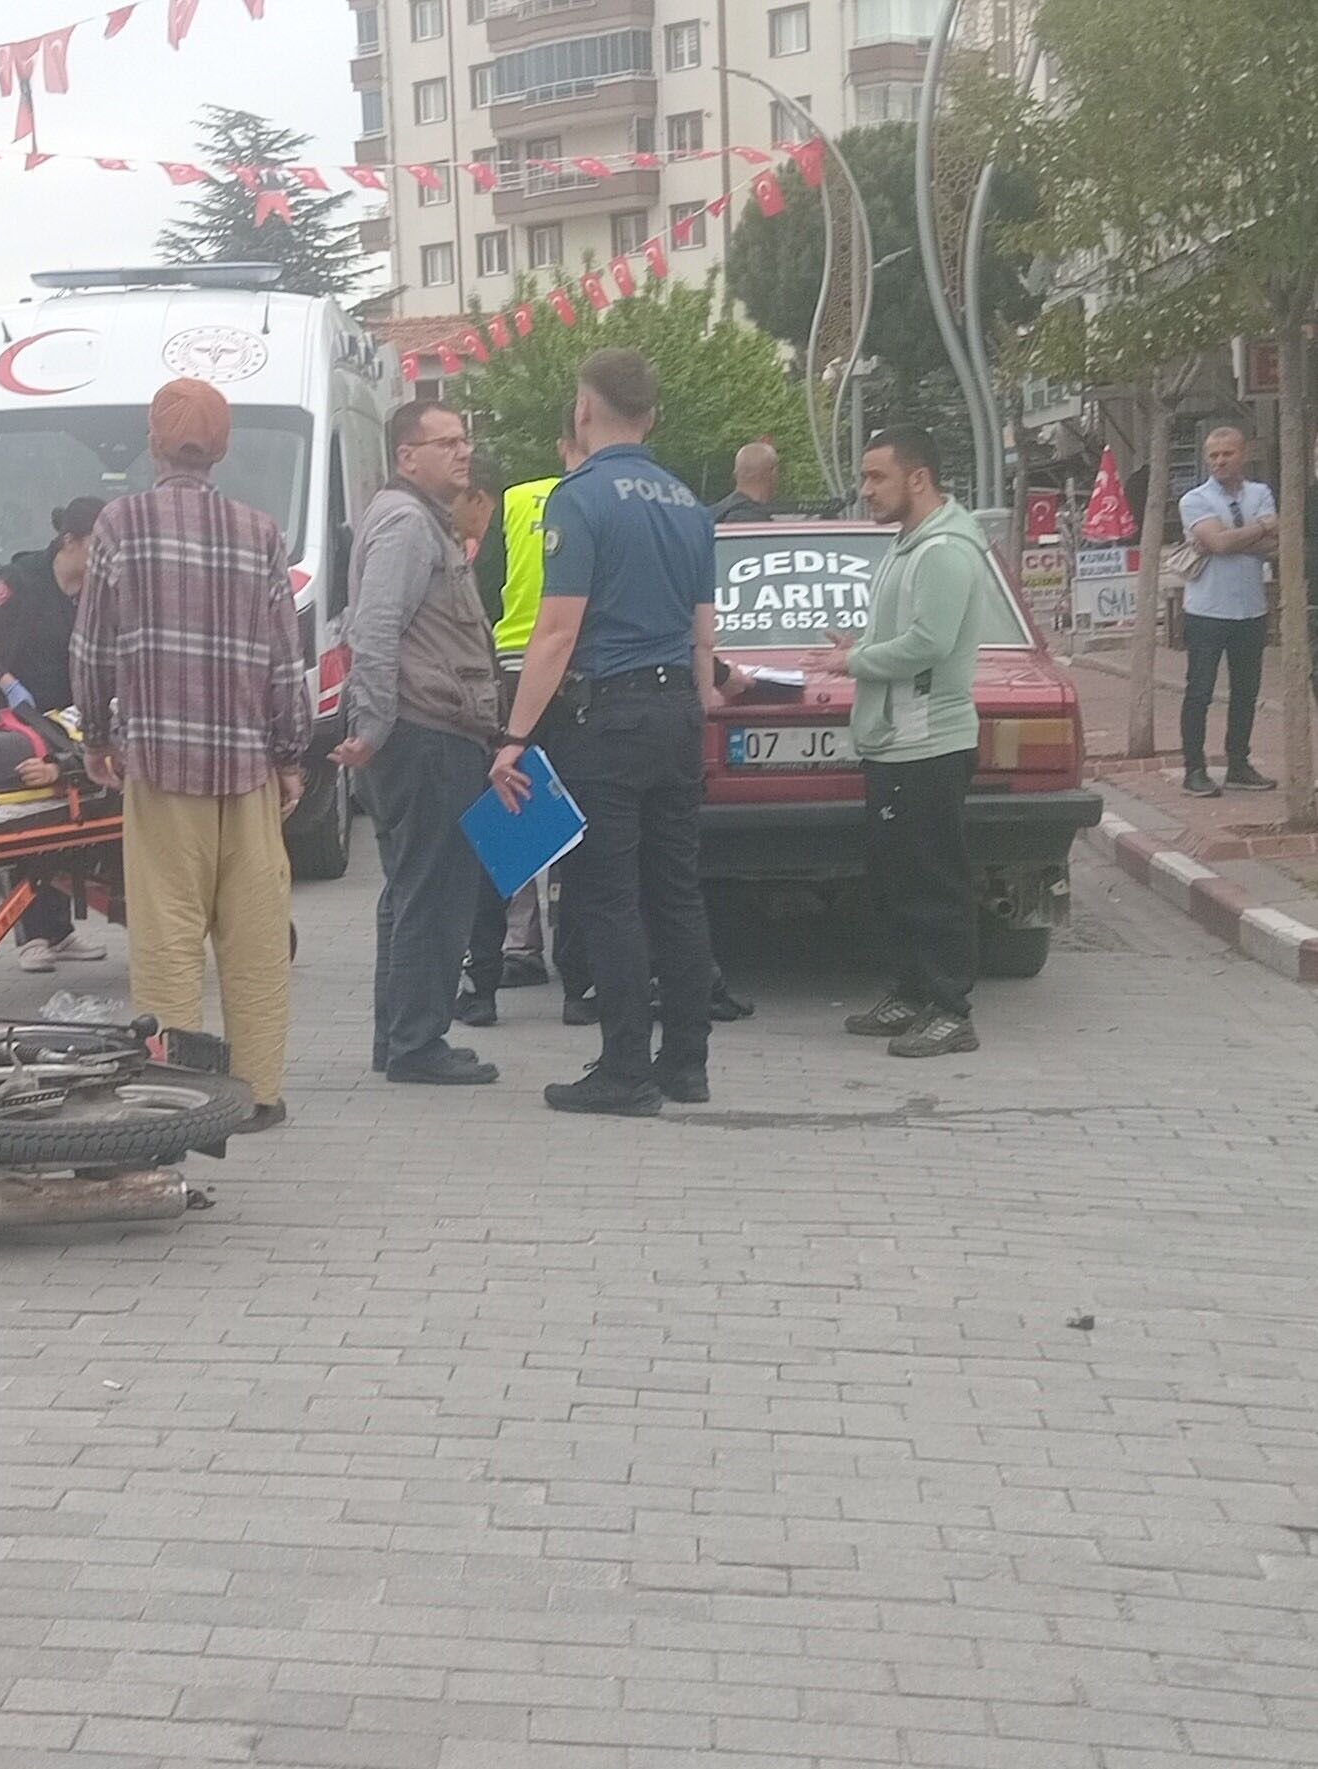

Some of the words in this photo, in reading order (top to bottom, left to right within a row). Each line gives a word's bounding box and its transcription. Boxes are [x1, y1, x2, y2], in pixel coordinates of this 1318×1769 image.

[613, 477, 696, 508] POLİS
[781, 610, 829, 630] 652
[836, 609, 869, 629] 30
[746, 732, 779, 759] 07
[801, 731, 835, 757] JC
